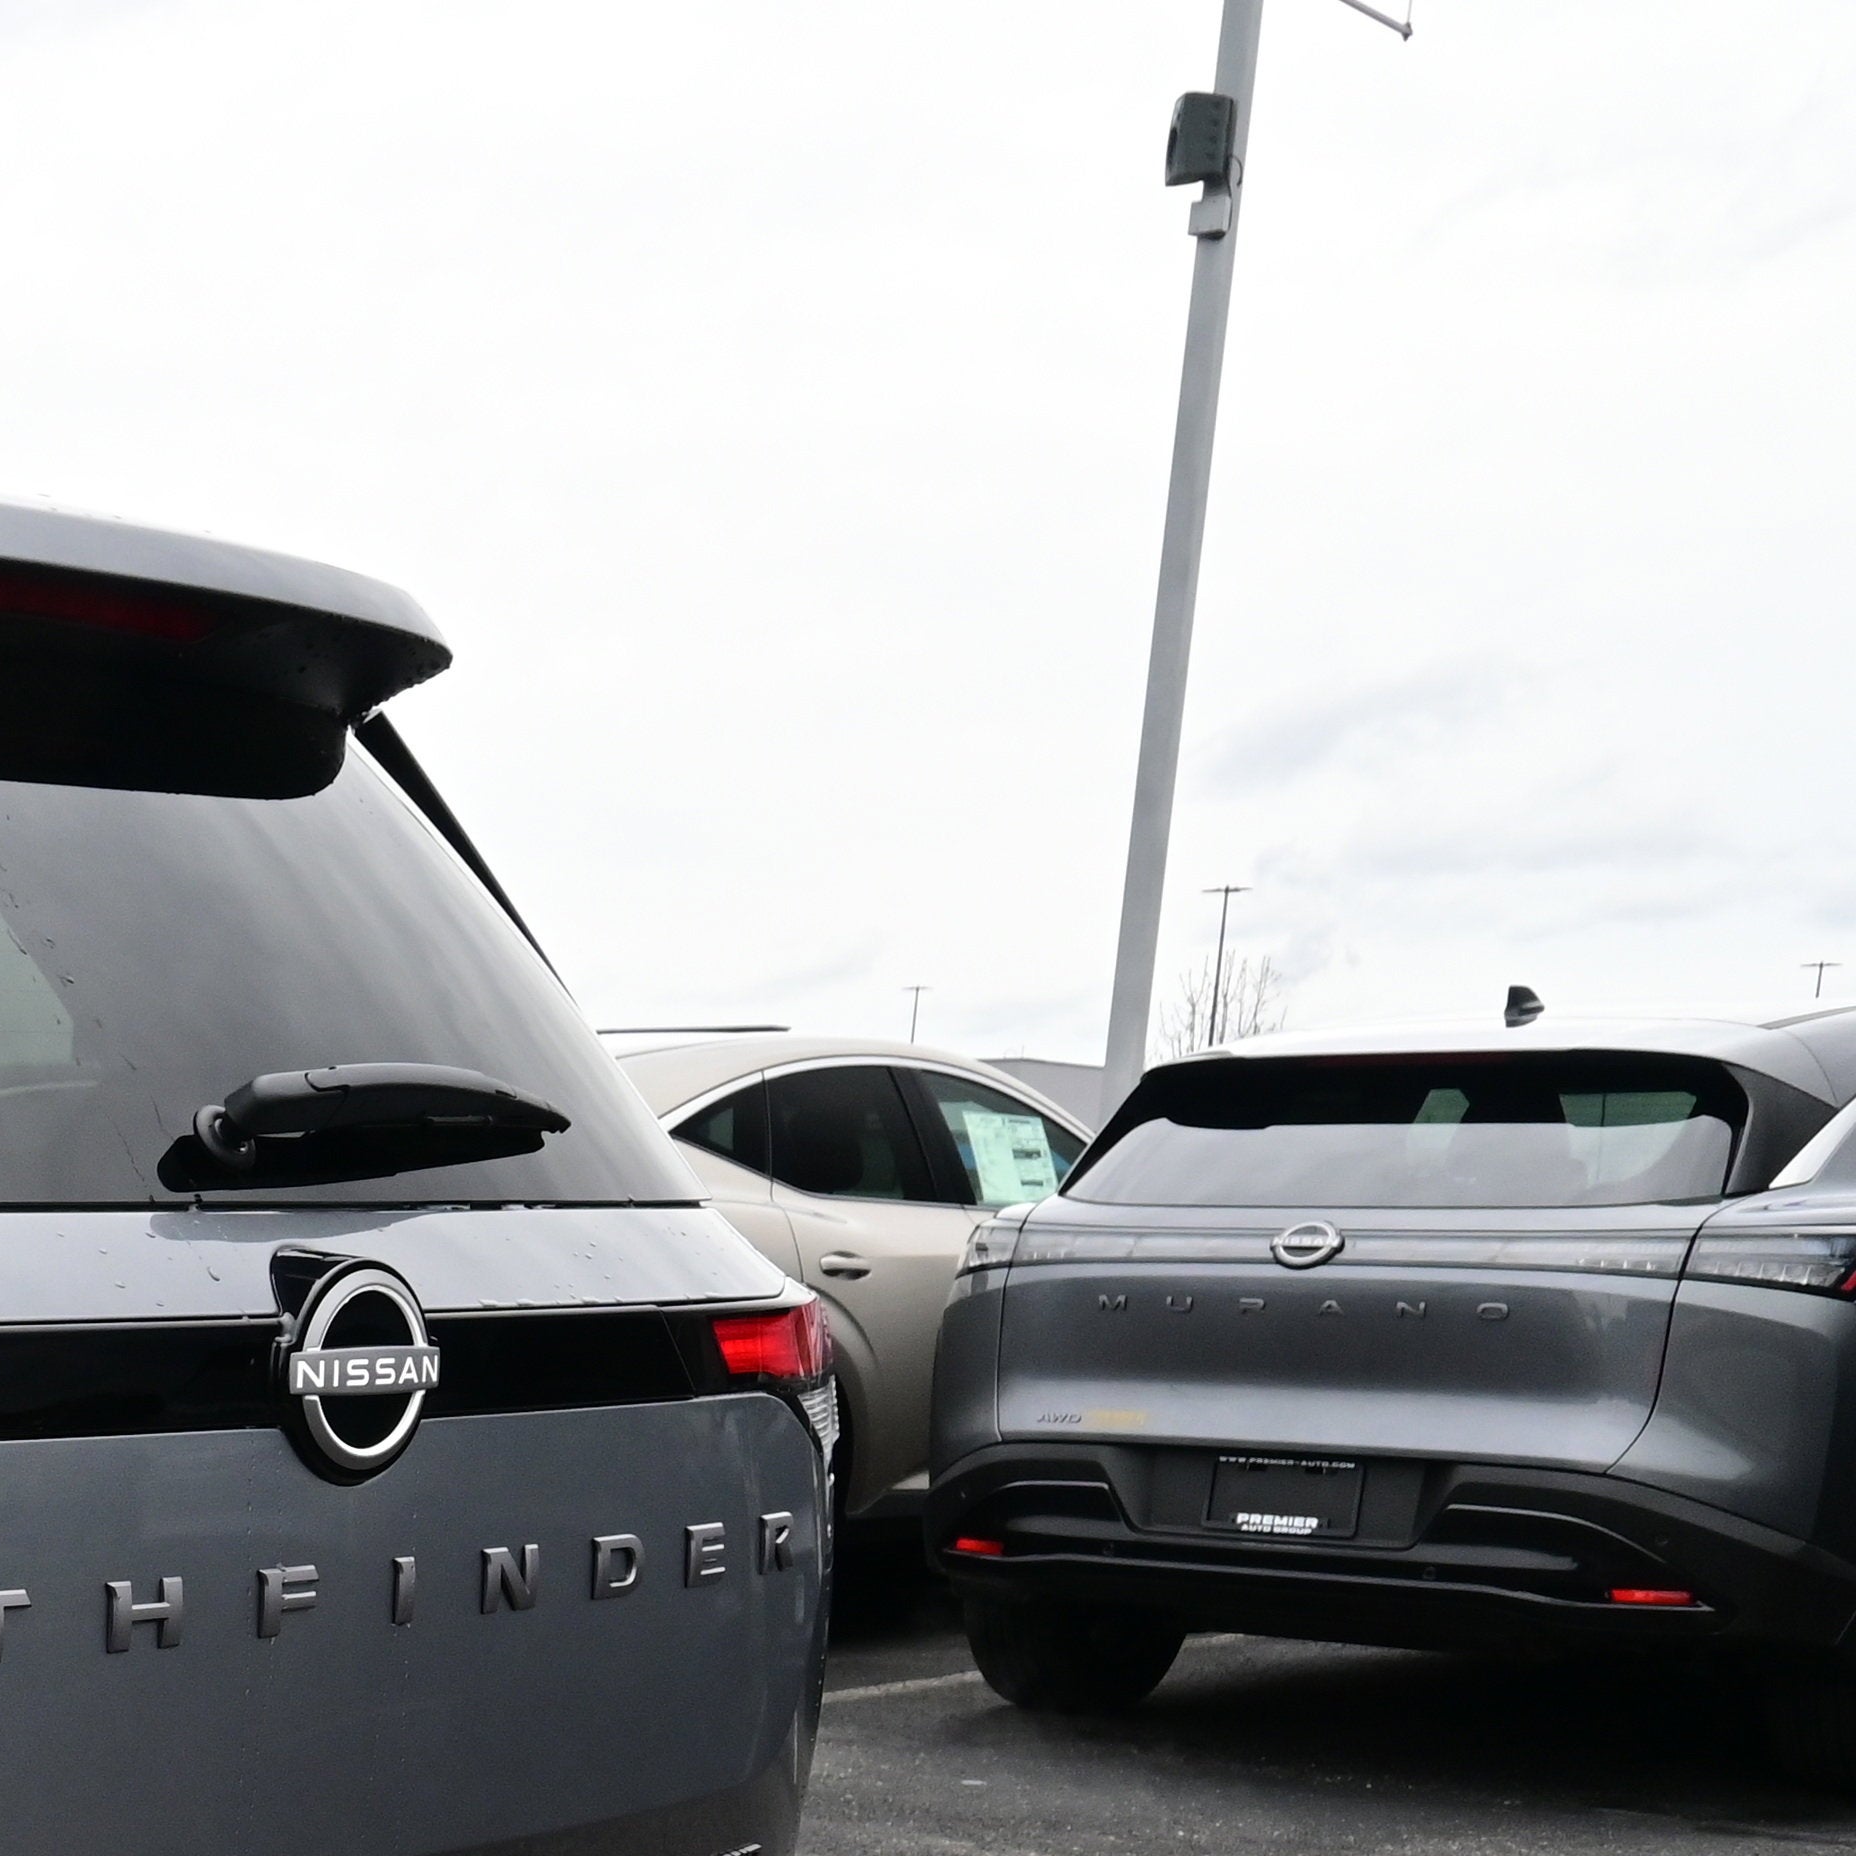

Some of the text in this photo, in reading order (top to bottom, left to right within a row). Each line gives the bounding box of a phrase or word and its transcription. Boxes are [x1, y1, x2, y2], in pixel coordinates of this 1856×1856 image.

[1098, 1294, 1510, 1321] MURANO
[296, 1355, 439, 1389] NISSAN
[1037, 1412, 1082, 1424] AWD
[1236, 1512, 1319, 1529] PREMIER
[1241, 1524, 1312, 1535] AUTO GROUP
